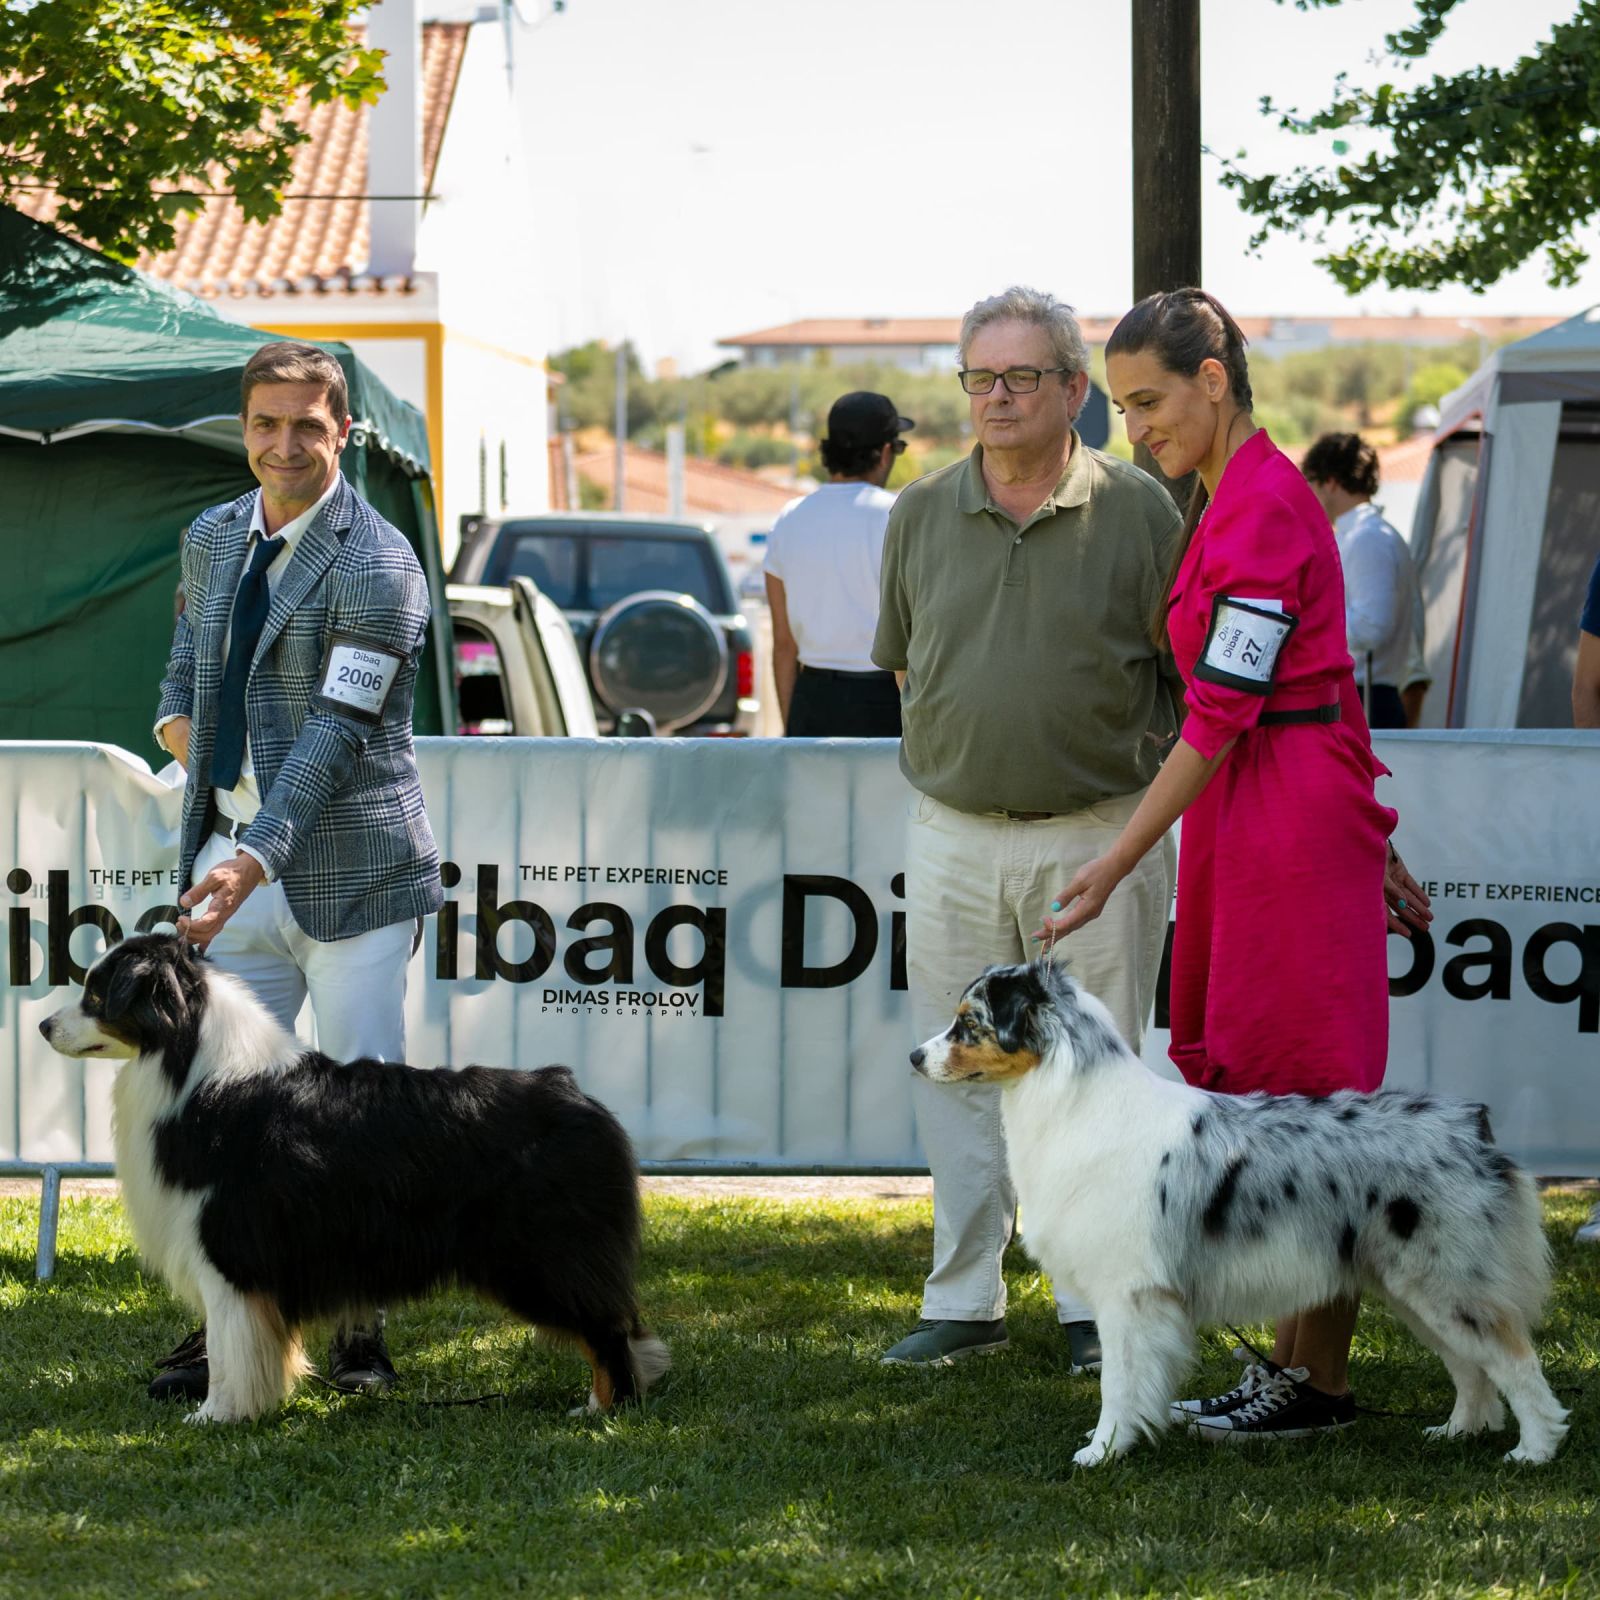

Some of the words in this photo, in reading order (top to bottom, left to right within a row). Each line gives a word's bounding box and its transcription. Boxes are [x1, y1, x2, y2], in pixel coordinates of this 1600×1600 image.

[1223, 629, 1243, 658] Dibaq
[1241, 638, 1262, 667] 27
[353, 651, 381, 666] Dibaq
[337, 666, 384, 691] 2006
[90, 869, 126, 885] THE
[132, 870, 164, 886] PET
[519, 865, 558, 881] THE
[564, 866, 600, 883] PET
[606, 867, 728, 885] EXPERIENCE
[1444, 883, 1480, 899] PET
